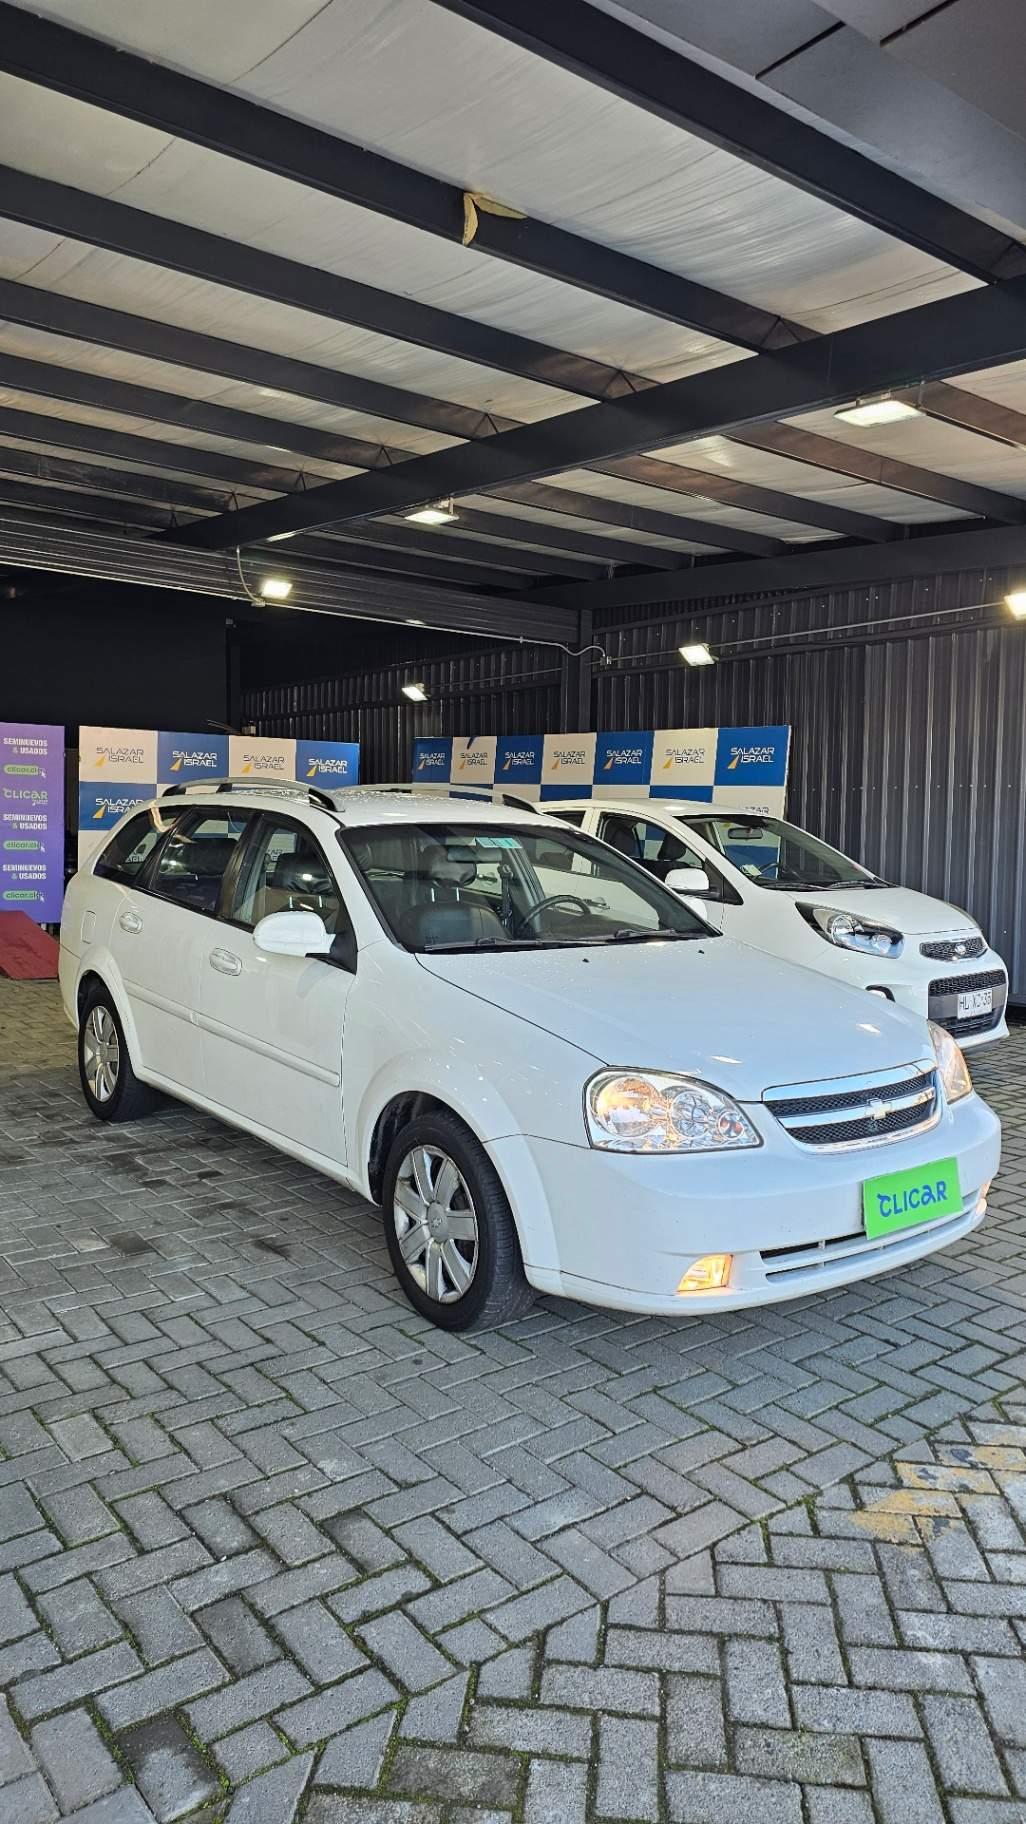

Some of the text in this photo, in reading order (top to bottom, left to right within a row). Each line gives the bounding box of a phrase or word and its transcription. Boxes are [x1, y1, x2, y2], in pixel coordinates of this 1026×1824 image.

[3, 737, 48, 747] SEMINUEVOS
[20, 747, 48, 755] USADOS
[96, 747, 144, 755] SALAZAR
[172, 750, 217, 760] SALAZAR
[504, 751, 535, 759] SALAZAR
[606, 749, 643, 757] SALAZAR
[665, 748, 705, 756] SALAZAR
[730, 747, 775, 755] SALAZAR
[108, 754, 144, 764] ISRAEL
[183, 758, 217, 767] ISRAEL
[243, 754, 285, 763] SALAZAR
[308, 758, 348, 767] SALAZAR
[560, 757, 585, 765] ISRAEL
[614, 756, 642, 764] ISRAEL
[674, 756, 705, 764] ISRAEL
[740, 754, 775, 763] ISRAEL
[254, 762, 285, 770] ISRAEL
[318, 765, 348, 774] ISRAEL
[3, 814, 48, 822] SEMINUEVOS
[19, 822, 47, 830] USADOS
[3, 864, 47, 872] SEMINUEVOS
[19, 872, 47, 880] USADOS
